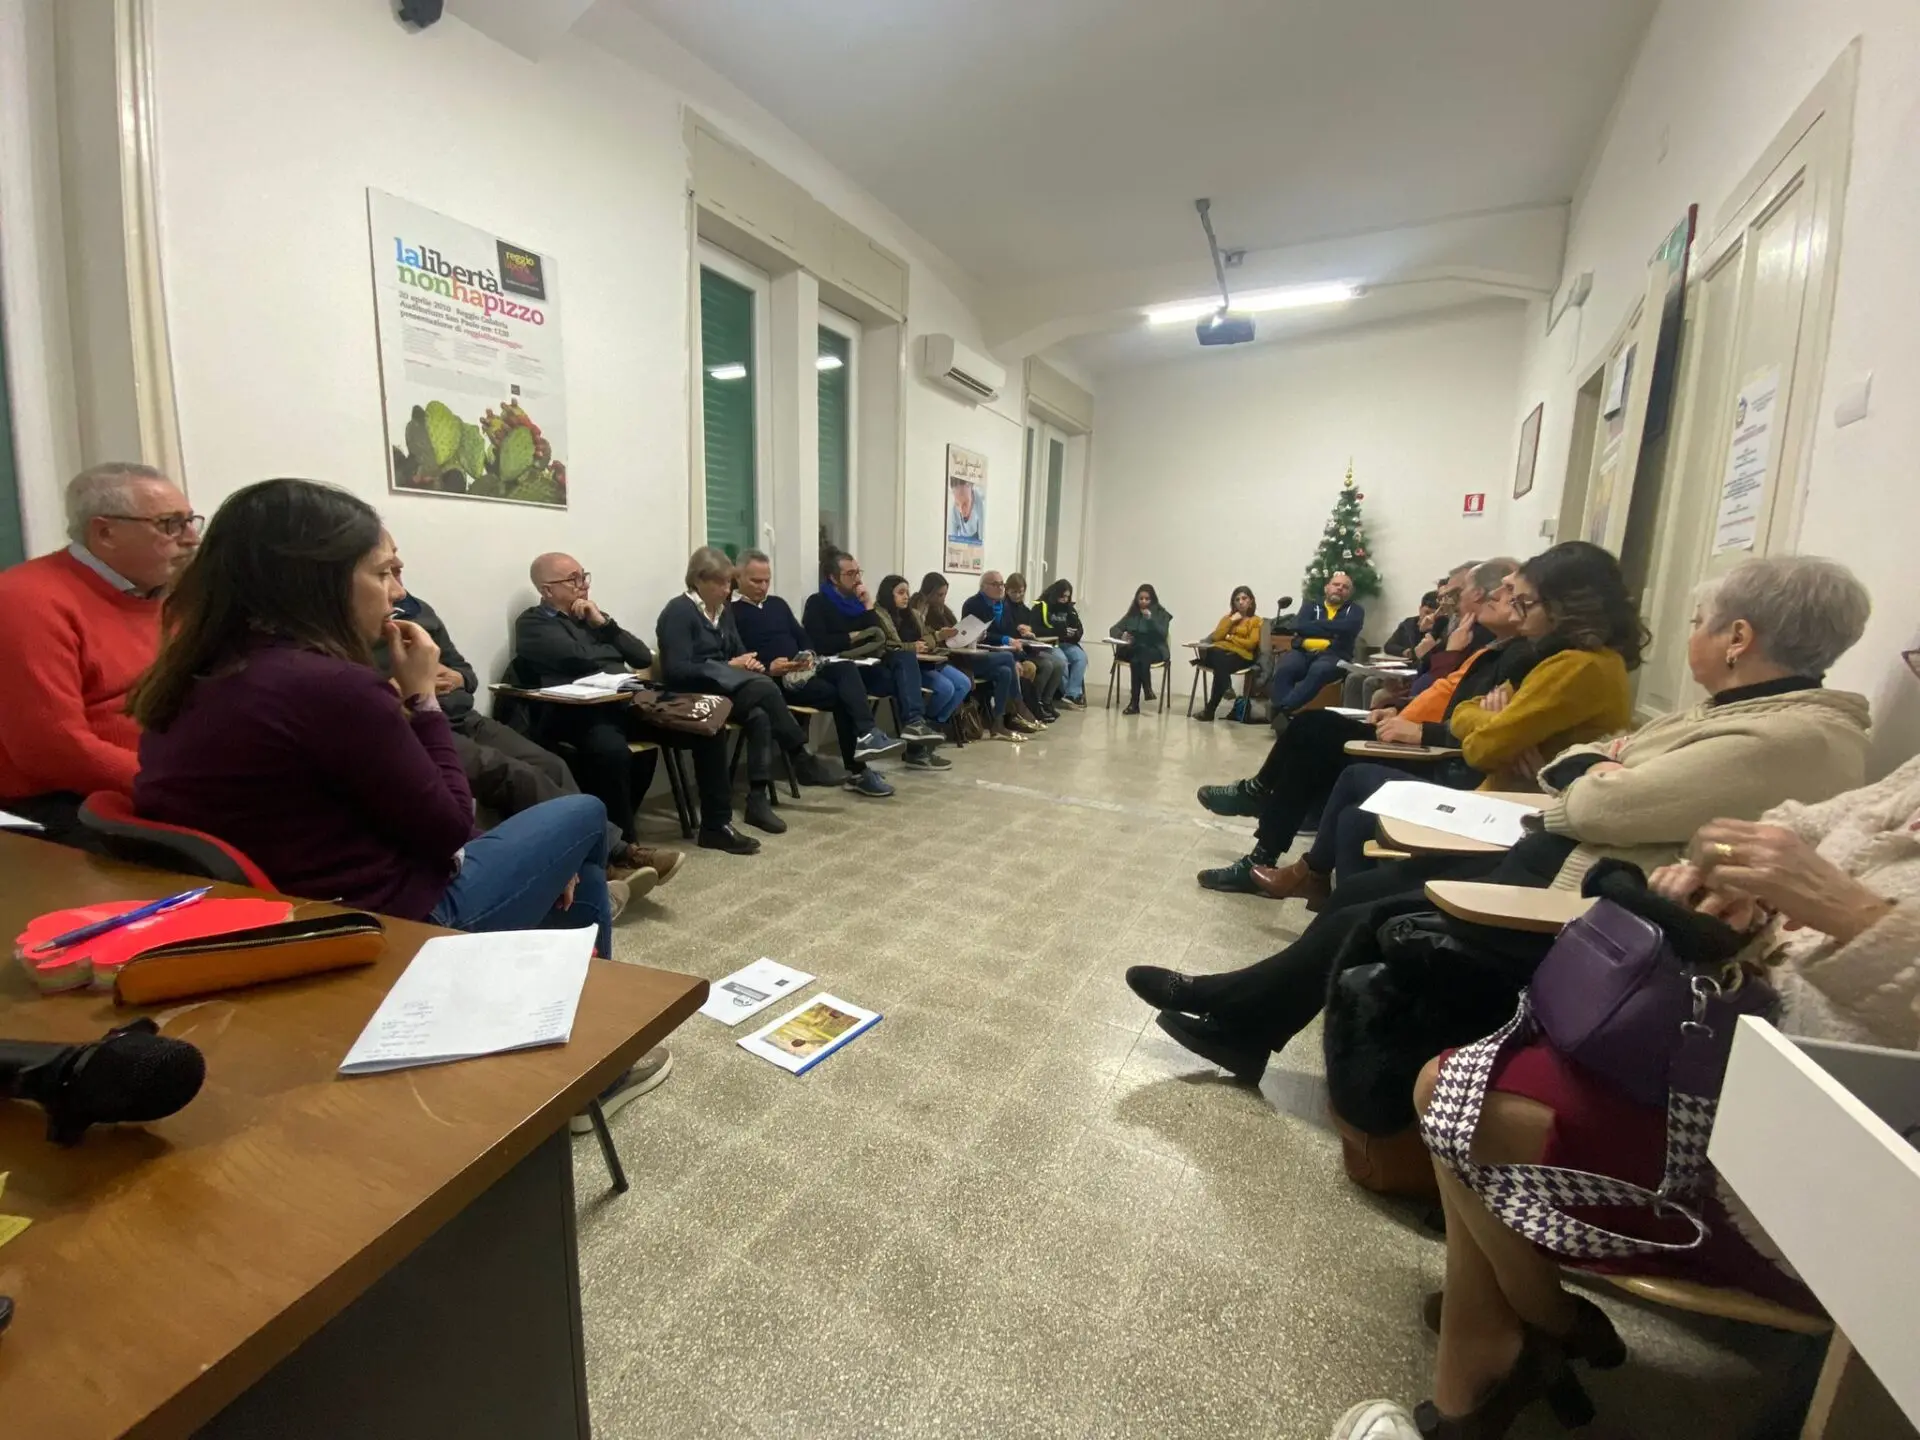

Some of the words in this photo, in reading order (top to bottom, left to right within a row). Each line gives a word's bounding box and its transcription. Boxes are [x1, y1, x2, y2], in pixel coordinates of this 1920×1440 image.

[397, 264, 544, 325] nonhapizzo
[400, 300, 444, 318] Auditorium
[445, 313, 459, 323] San
[461, 318, 480, 330] Paolo
[400, 310, 453, 329] presentazione
[411, 295, 431, 306] aprile
[456, 307, 480, 321] Reggio
[481, 314, 508, 329] Calabria
